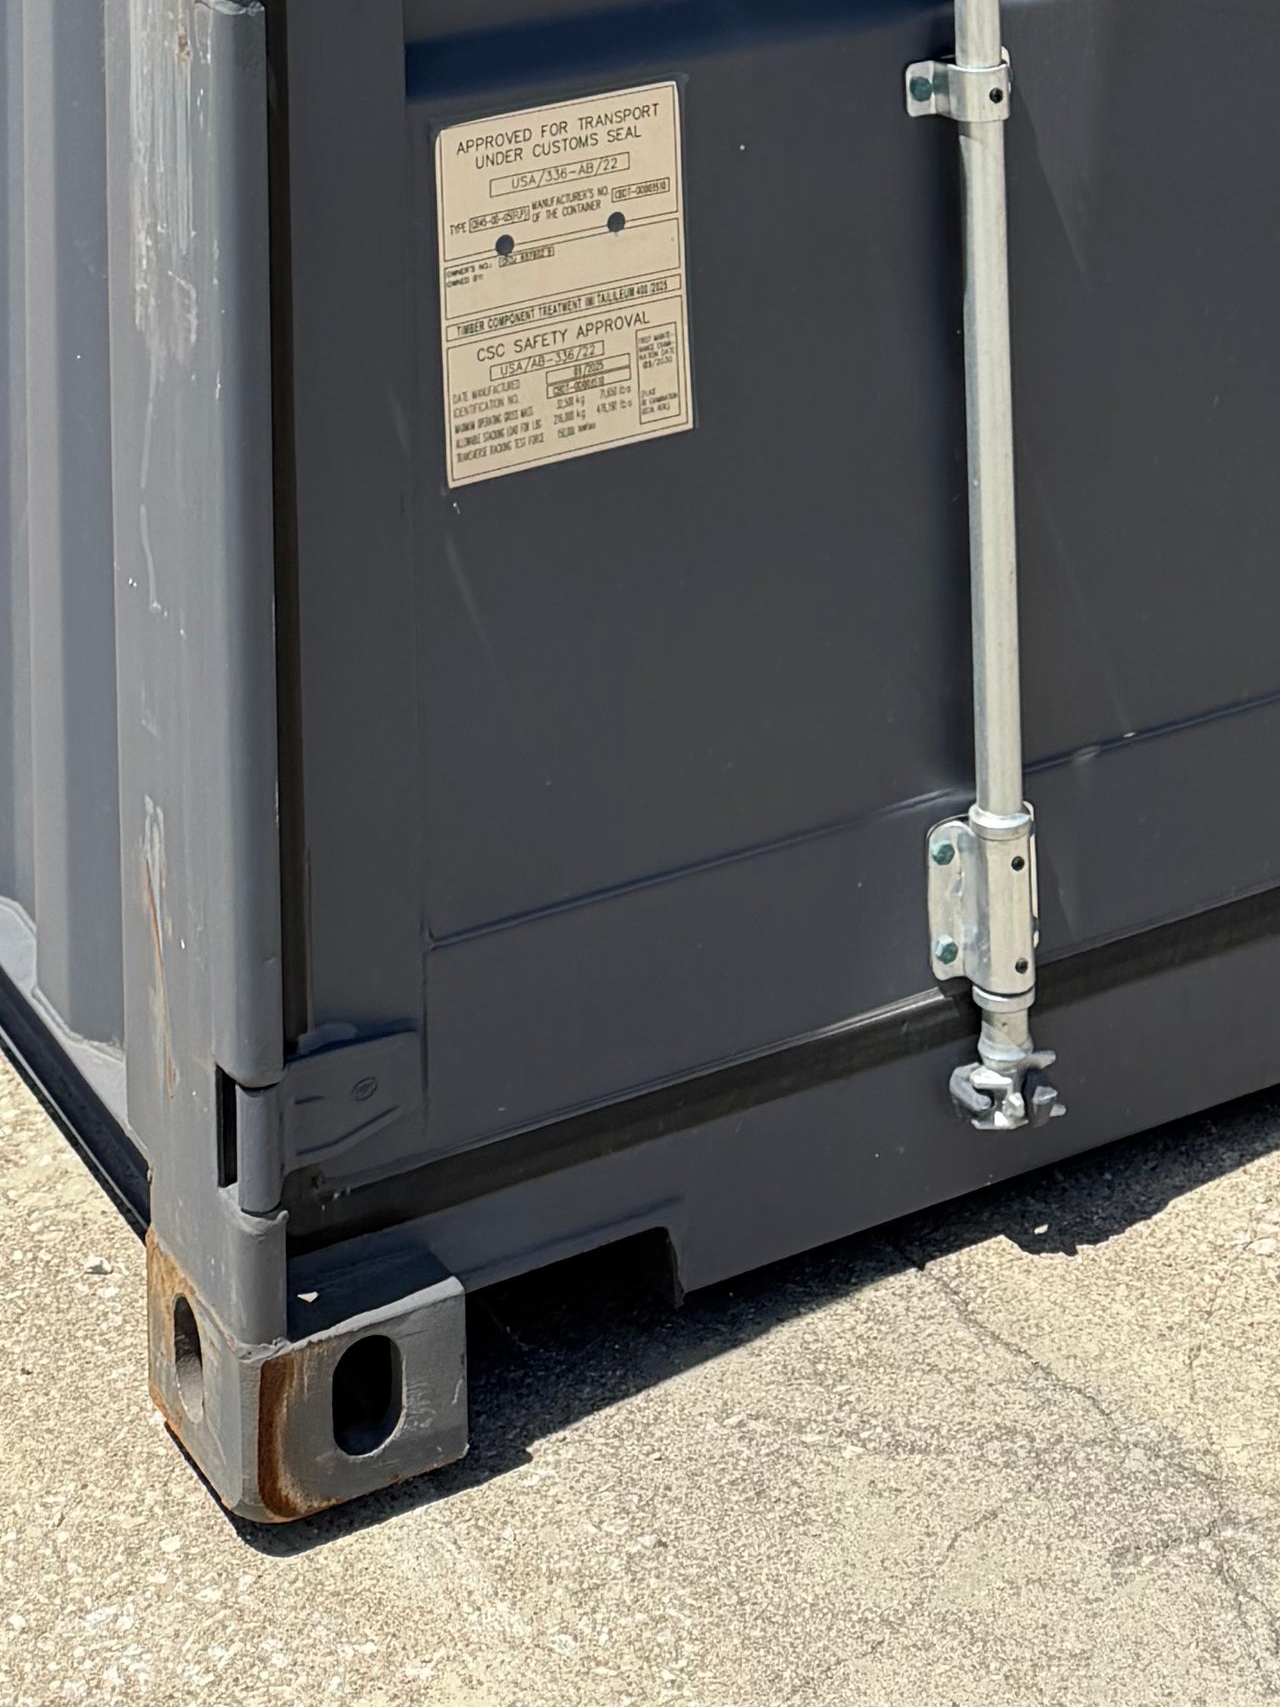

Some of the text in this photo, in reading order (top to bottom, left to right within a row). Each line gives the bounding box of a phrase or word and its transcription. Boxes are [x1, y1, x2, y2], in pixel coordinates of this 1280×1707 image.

[456, 103, 659, 155] APPROVED FOR TRANSPORT
[475, 125, 642, 170] UNDER CUSTOMS SEAL
[511, 157, 618, 189] USA/336-AB/22
[532, 187, 594, 210] MANUFACTURER'S
[532, 200, 602, 222] OF THE CONTAINER
[450, 221, 467, 235] TYPE
[457, 320, 484, 336] TIMBER
[487, 308, 535, 329] COMPONENT
[538, 298, 581, 317] TREATMENT
[477, 342, 505, 362] CSC
[513, 328, 568, 353] SAFETY
[576, 310, 650, 339] APPROVAL
[500, 344, 596, 377] USA/AB-336/22
